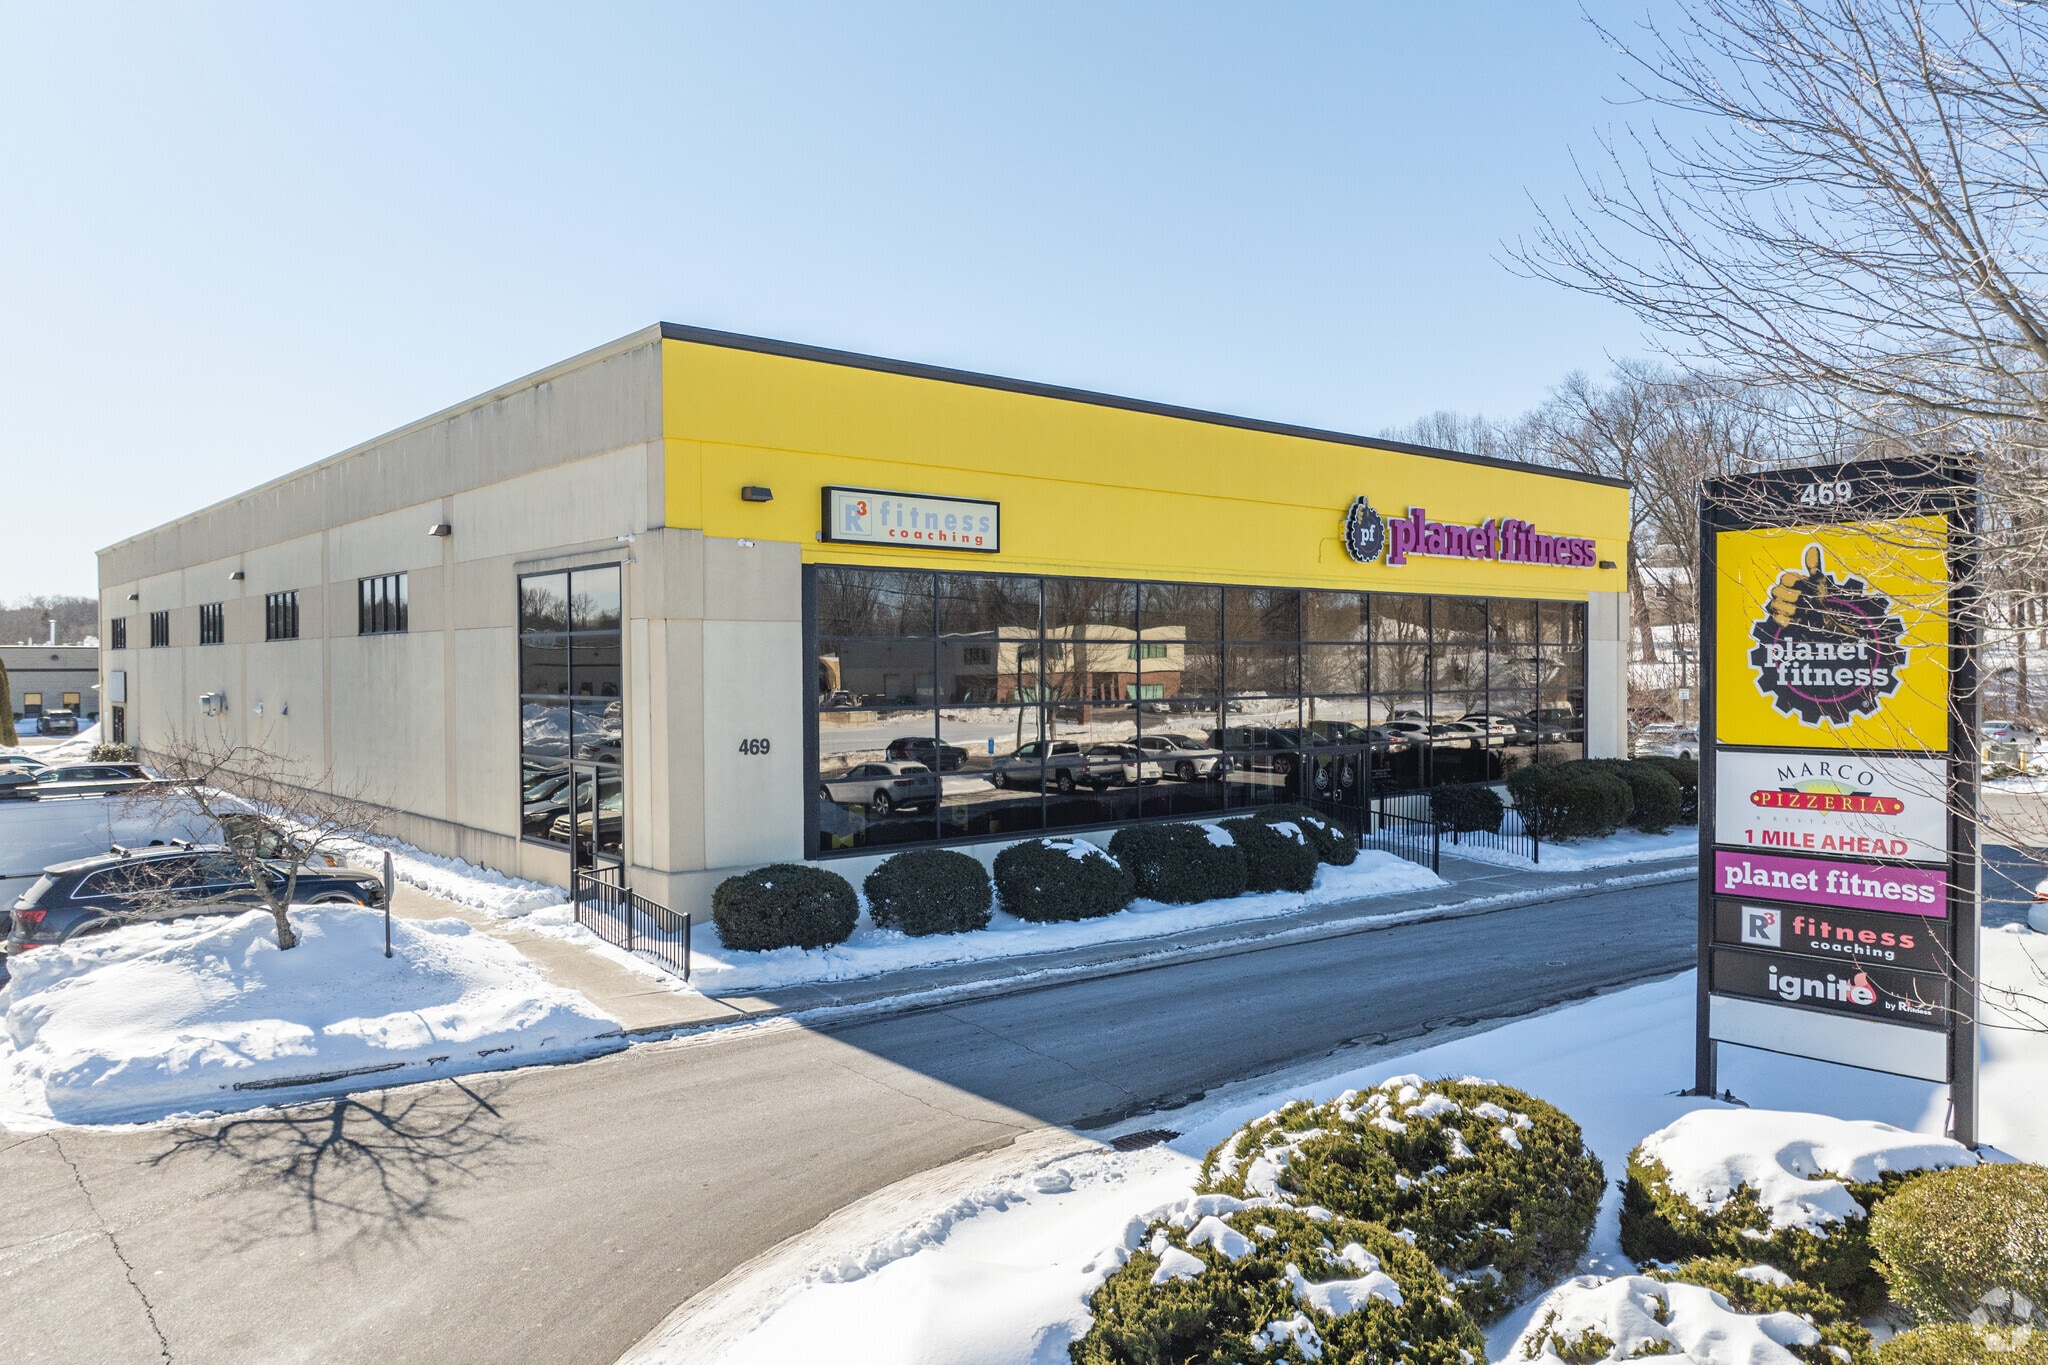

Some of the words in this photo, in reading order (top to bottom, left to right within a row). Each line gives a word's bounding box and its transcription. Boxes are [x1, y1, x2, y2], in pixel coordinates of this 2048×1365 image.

[1800, 481, 1852, 506] 469
[880, 500, 990, 533] fitness
[888, 528, 984, 546] coaching
[1360, 524, 1376, 546] pf
[1386, 507, 1498, 567] planet
[1499, 518, 1597, 567] fitness
[1764, 637, 1869, 668] planet
[1776, 661, 1889, 686] fitness
[738, 738, 770, 756] 469
[1777, 761, 1874, 786] MARCO
[1761, 793, 1886, 813] PIZZERIA
[1772, 816, 1898, 830] RESTAURANT
[1745, 829, 1753, 843] 1
[1762, 830, 1815, 848] MILE
[1821, 835, 1908, 856] AHEAD
[1724, 862, 1818, 891] planet
[1826, 870, 1935, 904] fitness
[1792, 916, 1915, 949] fitness
[1810, 940, 1895, 961] coaching
[1768, 965, 1874, 1005] ignite
[1885, 1001, 1896, 1011] by
